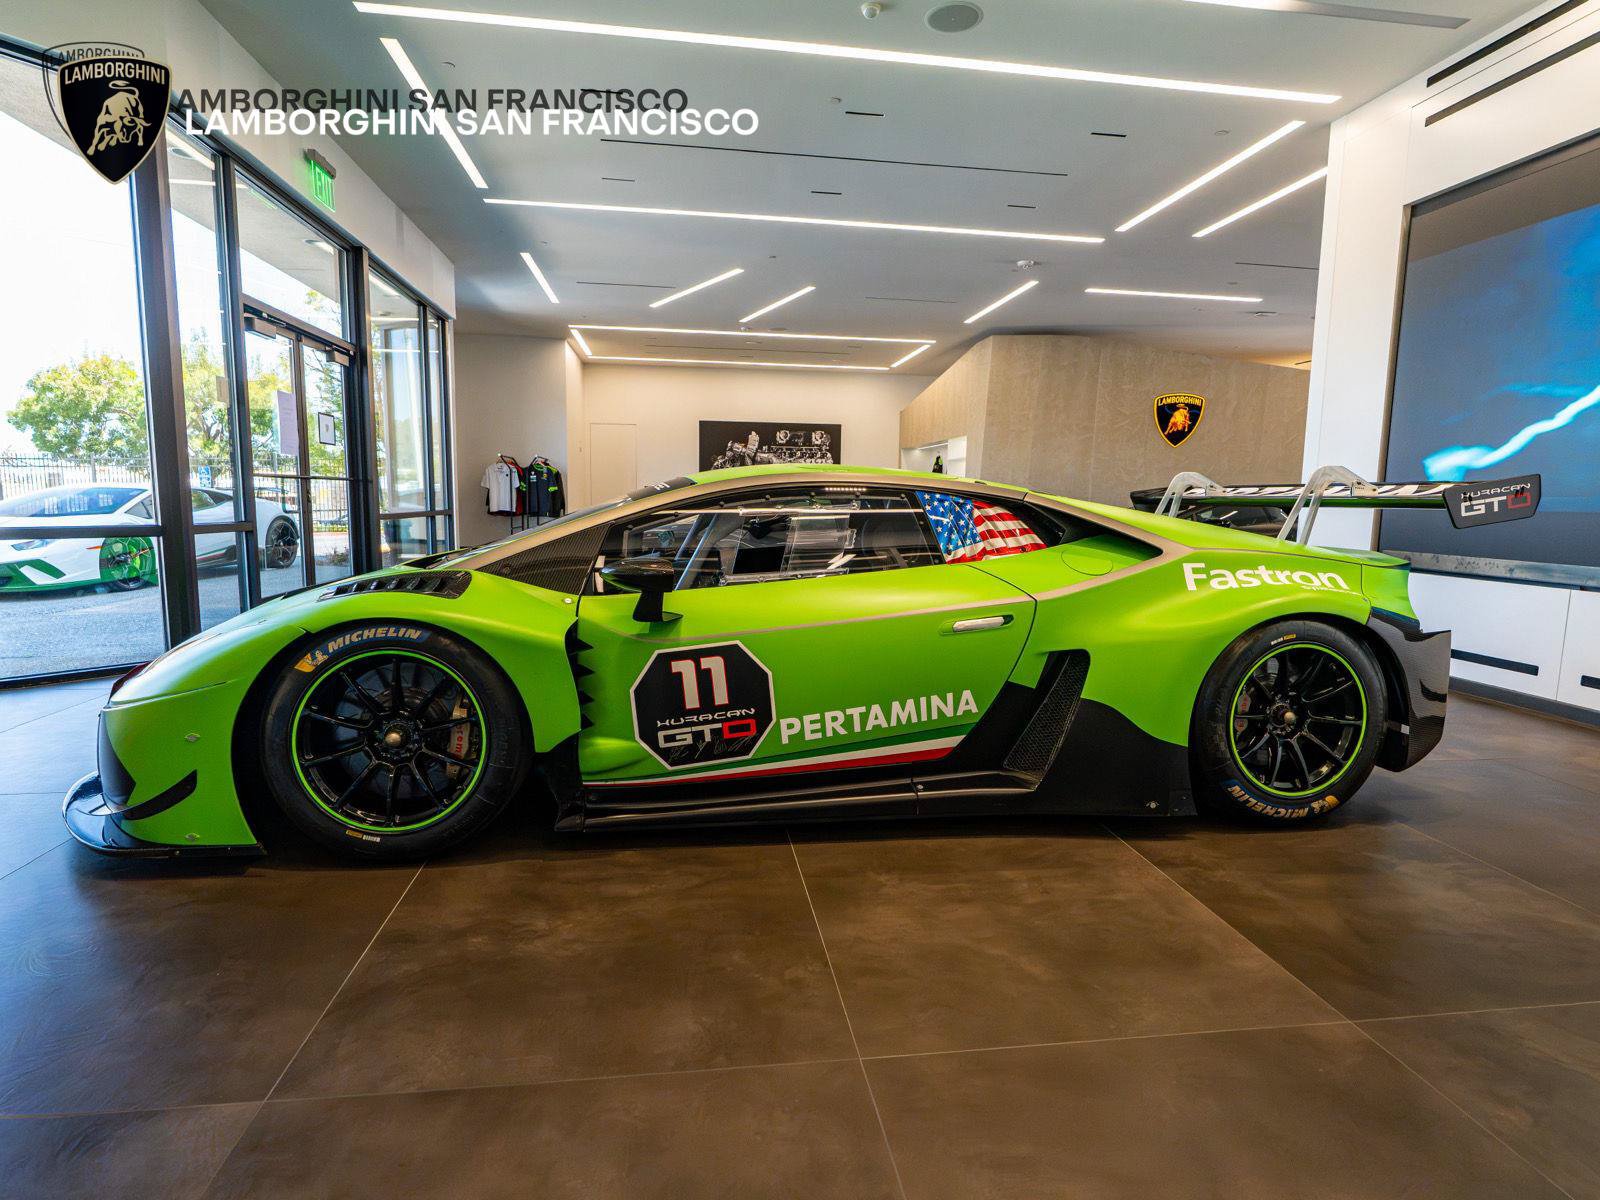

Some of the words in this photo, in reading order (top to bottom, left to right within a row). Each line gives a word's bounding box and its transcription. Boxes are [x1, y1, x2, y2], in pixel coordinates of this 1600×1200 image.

[314, 164, 335, 209] EXIT
[1158, 396, 1202, 406] LAMBORGHINI
[1182, 562, 1350, 591] Fastron
[327, 627, 422, 653] MICHELIN
[670, 655, 729, 710] 11
[779, 689, 979, 745] PERTAMINA
[1227, 785, 1309, 818] MICHELIN
